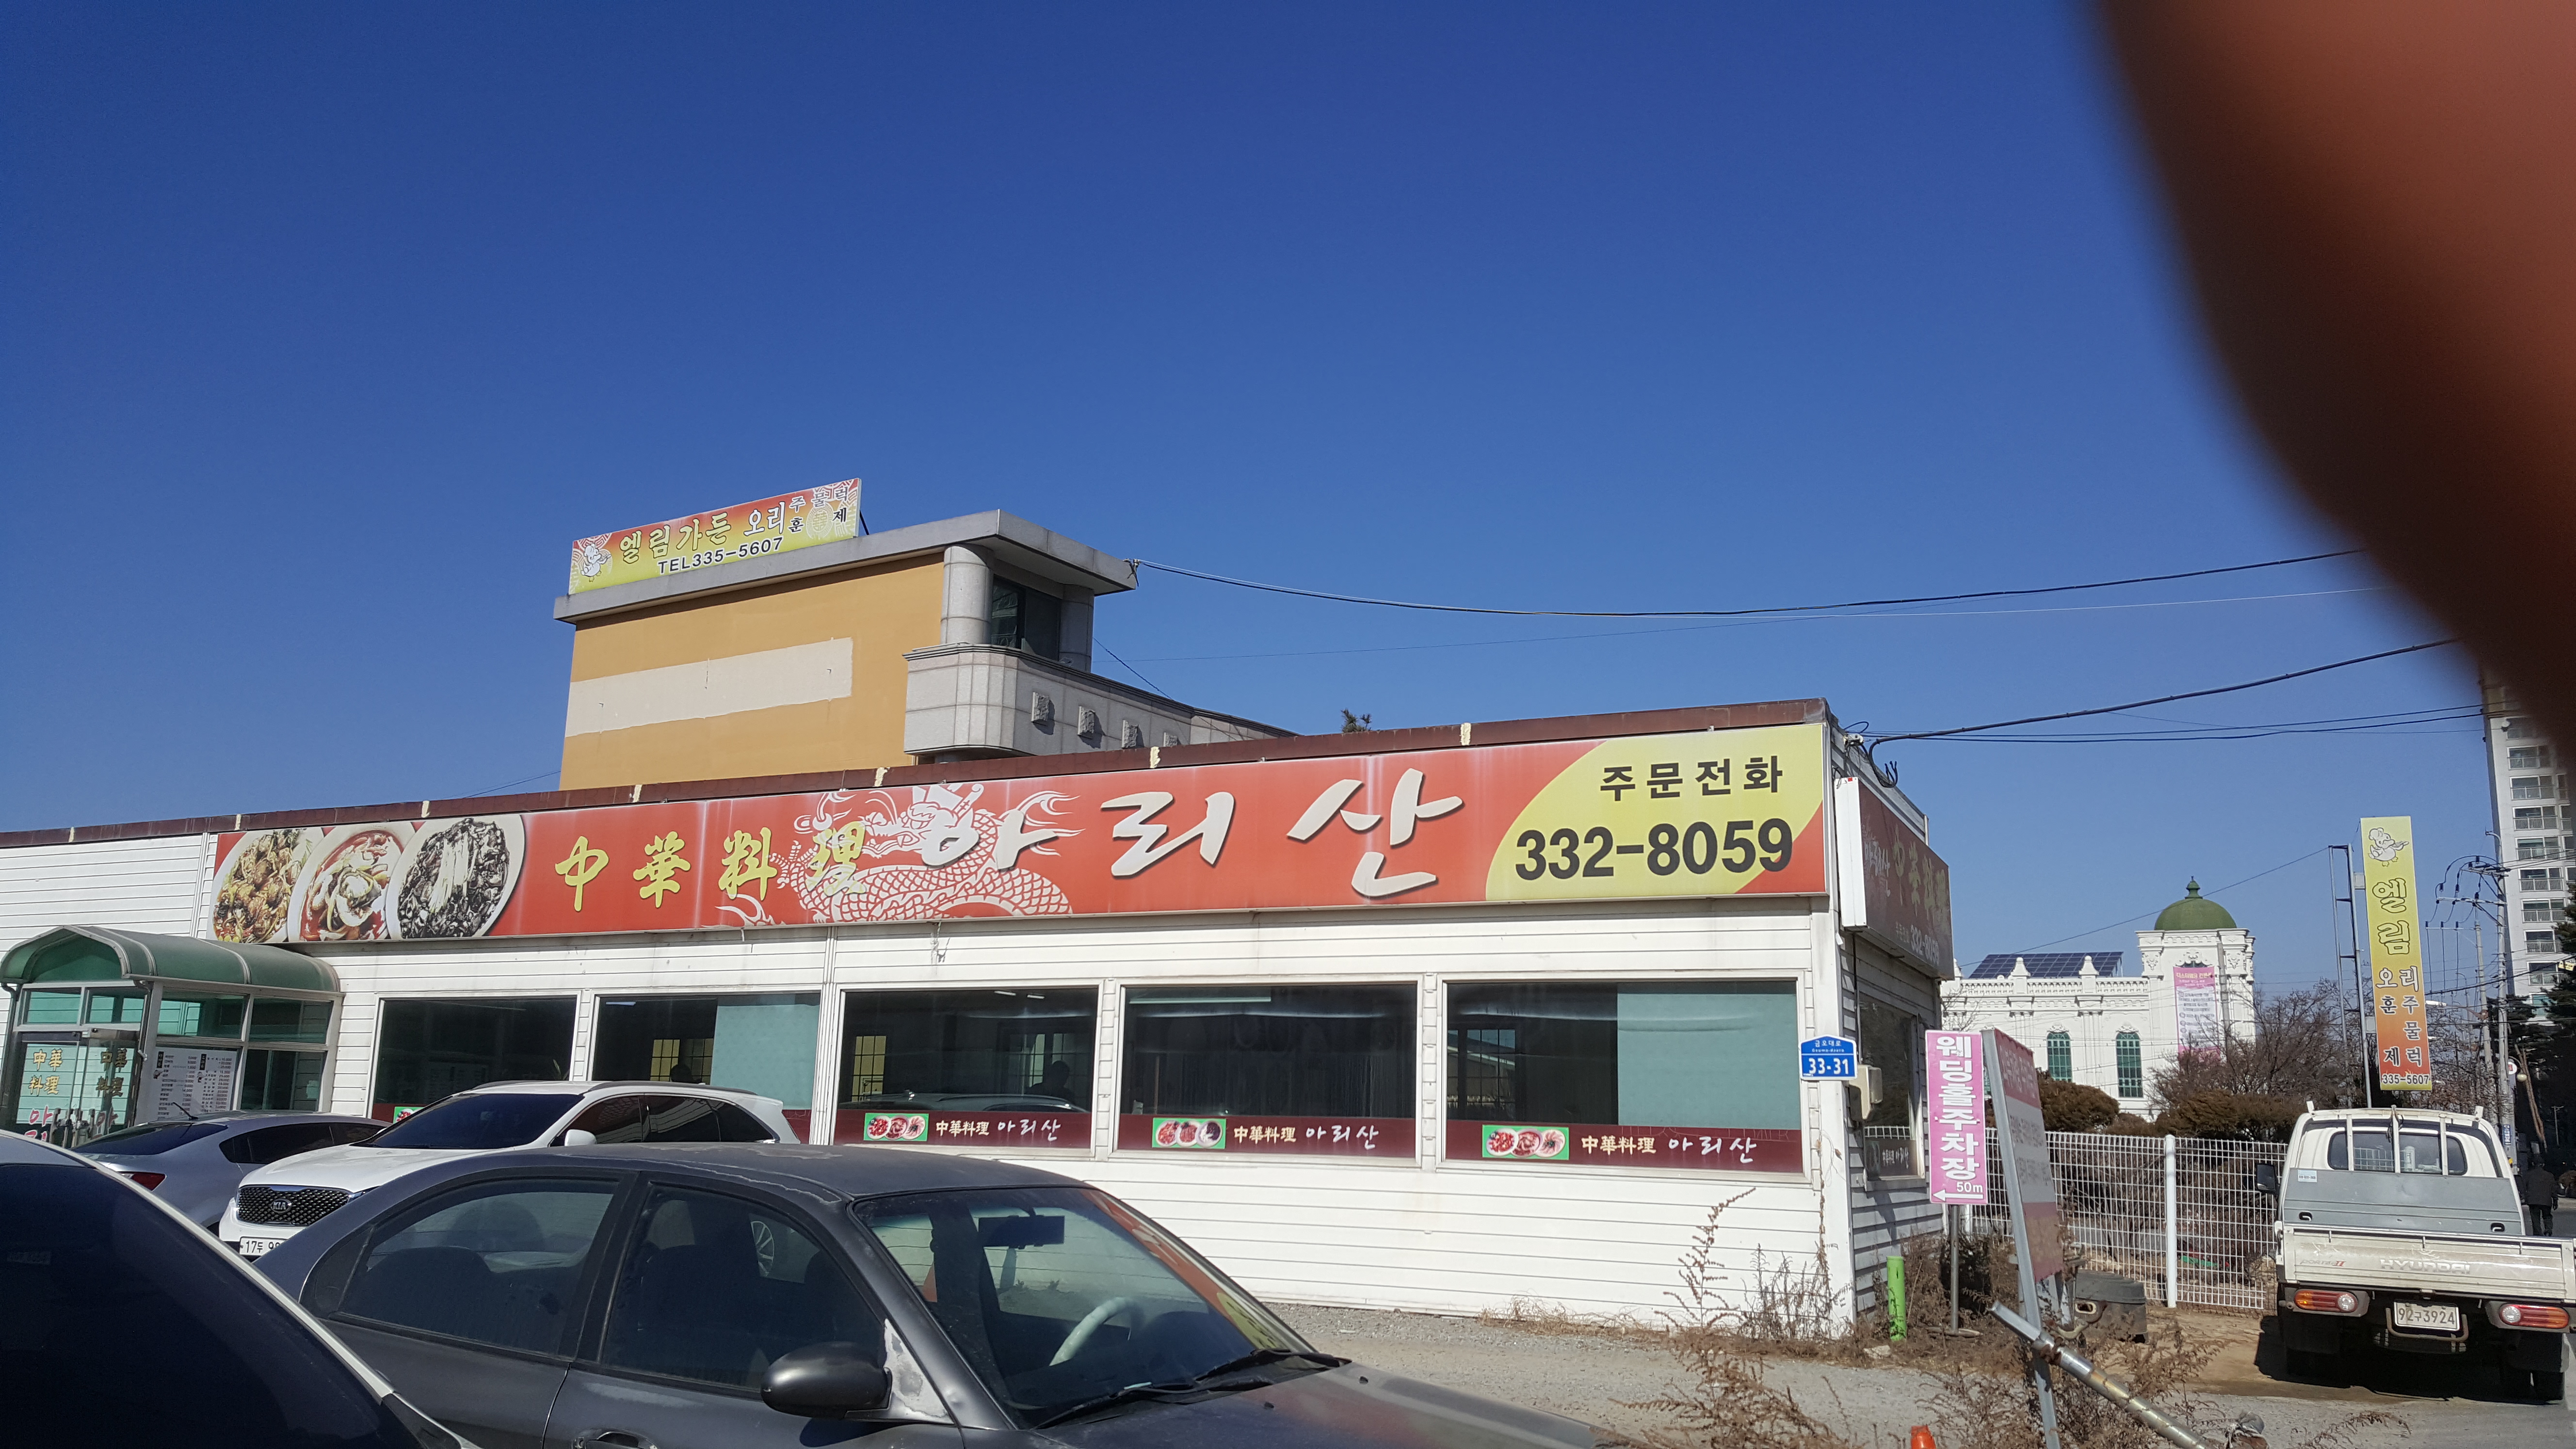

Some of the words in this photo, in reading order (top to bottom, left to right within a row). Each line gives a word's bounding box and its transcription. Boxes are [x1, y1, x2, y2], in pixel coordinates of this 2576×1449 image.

[619, 512, 731, 564] 엘림가든
[743, 501, 785, 537] 오리
[789, 486, 848, 513] 주물럭
[788, 508, 847, 533] 훈제
[658, 537, 783, 574] TEL335-5607
[1600, 755, 1783, 801] 주문전화
[554, 821, 867, 912] 中華料理
[921, 768, 1464, 898] 아리산
[1515, 818, 1792, 880] 332-8059
[2372, 878, 2410, 955] 엘림
[2376, 966, 2419, 992] 오리
[2381, 996, 2400, 1067] 훈제
[2401, 996, 2422, 1066] 주물럭
[33, 1048, 63, 1071] 中華
[1809, 1058, 1849, 1074] 33-31
[28, 1075, 60, 1096] 料理
[2382, 1074, 2429, 1084] 335-5607
[1936, 1036, 1980, 1180] 웨딩홀주차장
[936, 1121, 989, 1138] 中華料理
[997, 1119, 1061, 1141] 아리산
[1234, 1126, 1296, 1143] 中華料理
[1305, 1125, 1379, 1149] 아리산
[1582, 1135, 1656, 1156] 中華料理
[1668, 1136, 1756, 1163] 아리산
[1956, 1182, 1983, 1193] 50m
[273, 1201, 287, 1210] KIA
[246, 1240, 263, 1253] 17두
[2380, 1259, 2470, 1274] HYUNDAI
[2399, 1308, 2455, 1324] 92구3924
